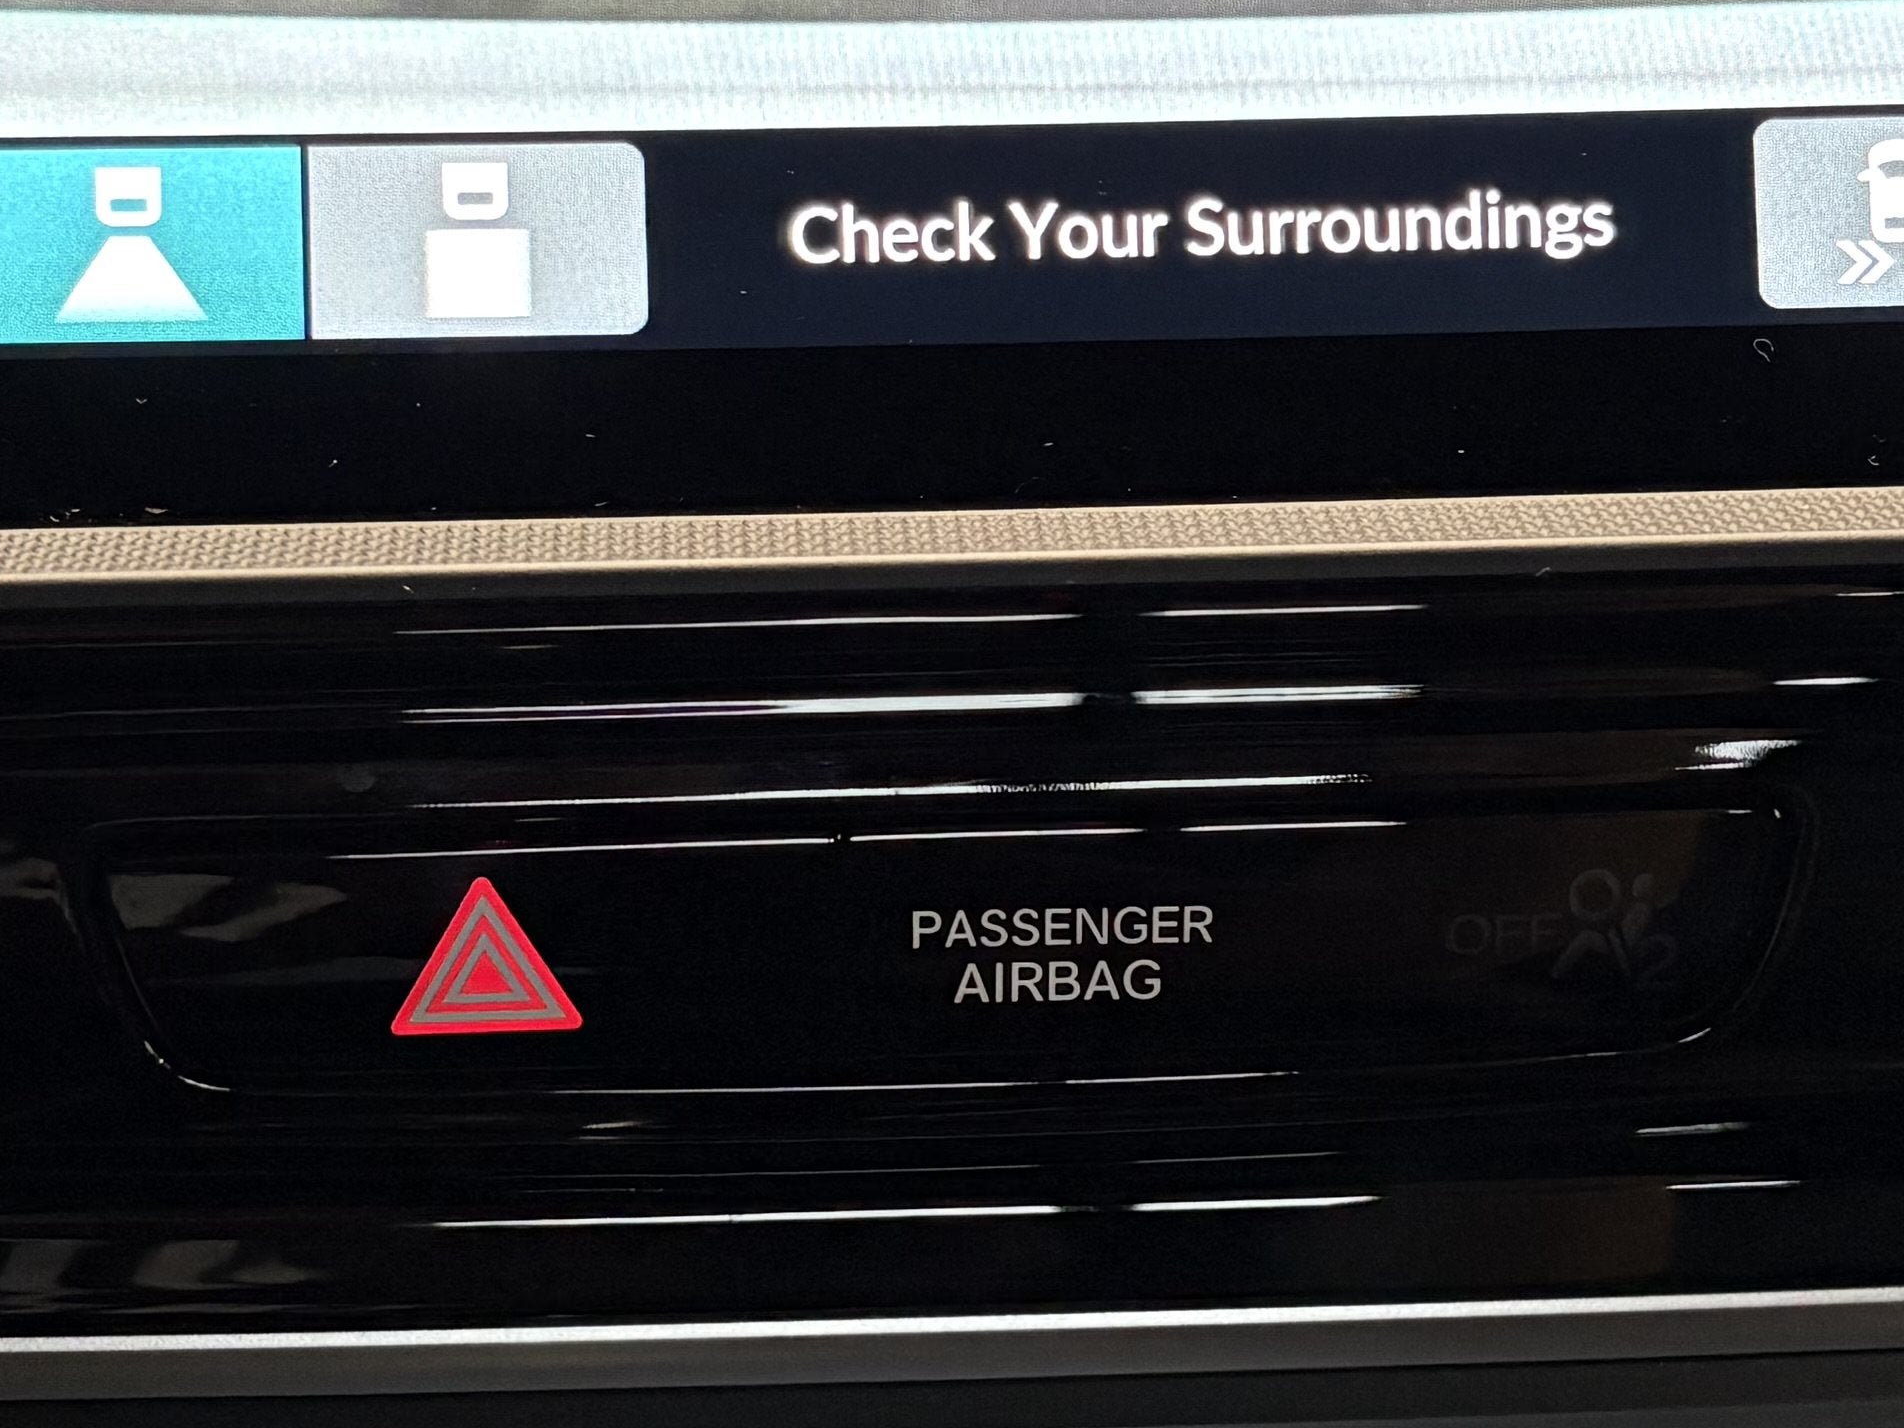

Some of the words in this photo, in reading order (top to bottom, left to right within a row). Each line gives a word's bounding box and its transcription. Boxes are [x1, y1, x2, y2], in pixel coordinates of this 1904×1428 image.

[785, 197, 998, 267] Check
[1005, 198, 1171, 262] Your
[1183, 186, 1619, 262] Surroundings
[910, 903, 1215, 951] PASSENGER
[1443, 912, 1566, 957] OFF
[951, 957, 1163, 1006] AIRBAG
